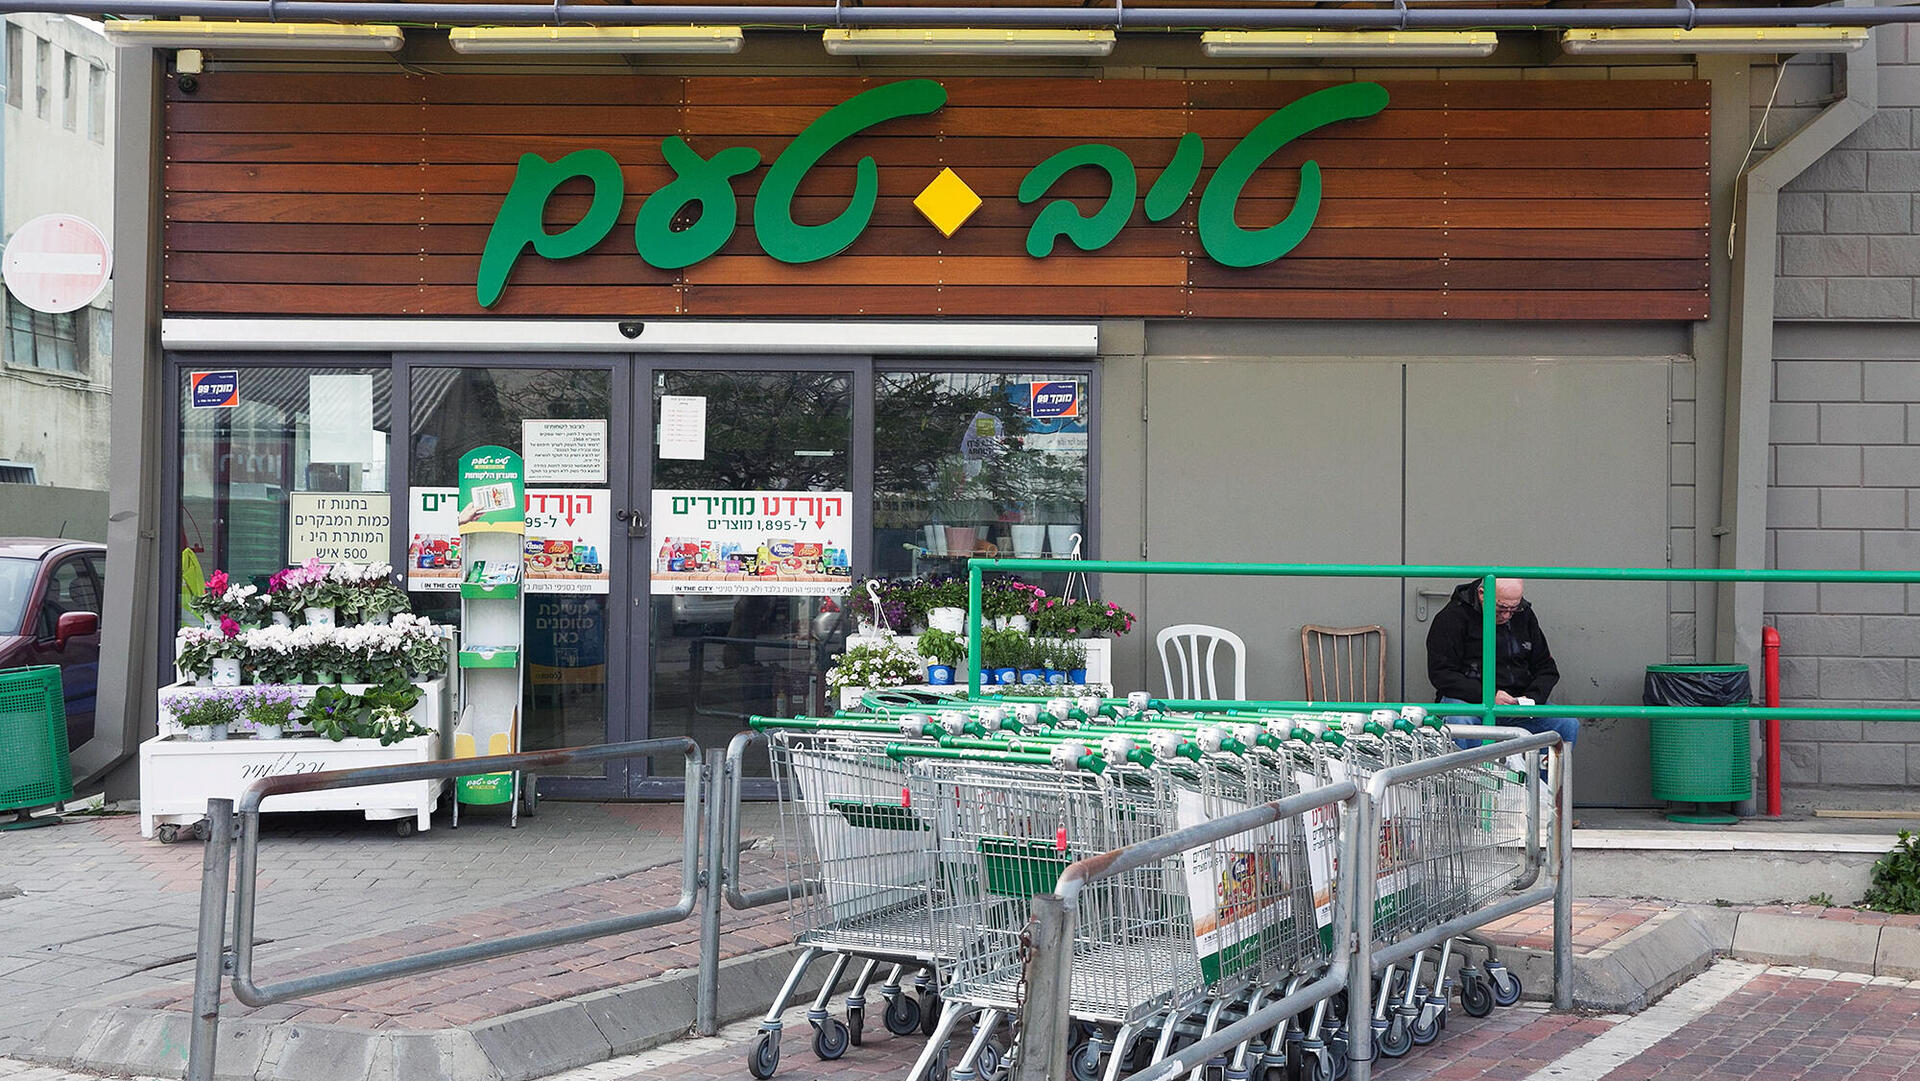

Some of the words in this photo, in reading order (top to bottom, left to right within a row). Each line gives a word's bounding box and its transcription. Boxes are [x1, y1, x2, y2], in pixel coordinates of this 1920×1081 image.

[1018, 82, 1391, 268] טיב
[476, 79, 949, 308] טעם
[197, 384, 210, 394] 99
[210, 384, 234, 394] מוקד
[1050, 394, 1073, 404] מוקד
[464, 471, 495, 481] הלקוחות
[317, 499, 326, 510] זו
[331, 499, 368, 510] בחנות
[524, 495, 592, 521] הורדנ
[672, 496, 755, 516] מחירים
[762, 496, 842, 523] הורדנו
[295, 515, 353, 528] המבקרים
[358, 516, 390, 527] כמות
[707, 519, 753, 530] מוצרים
[757, 518, 807, 532] ל-1,895
[333, 531, 384, 543] המותרת
[316, 548, 340, 559] איש
[344, 548, 368, 559] 500
[535, 617, 594, 630] מזומנים
[553, 631, 579, 646] כאן
